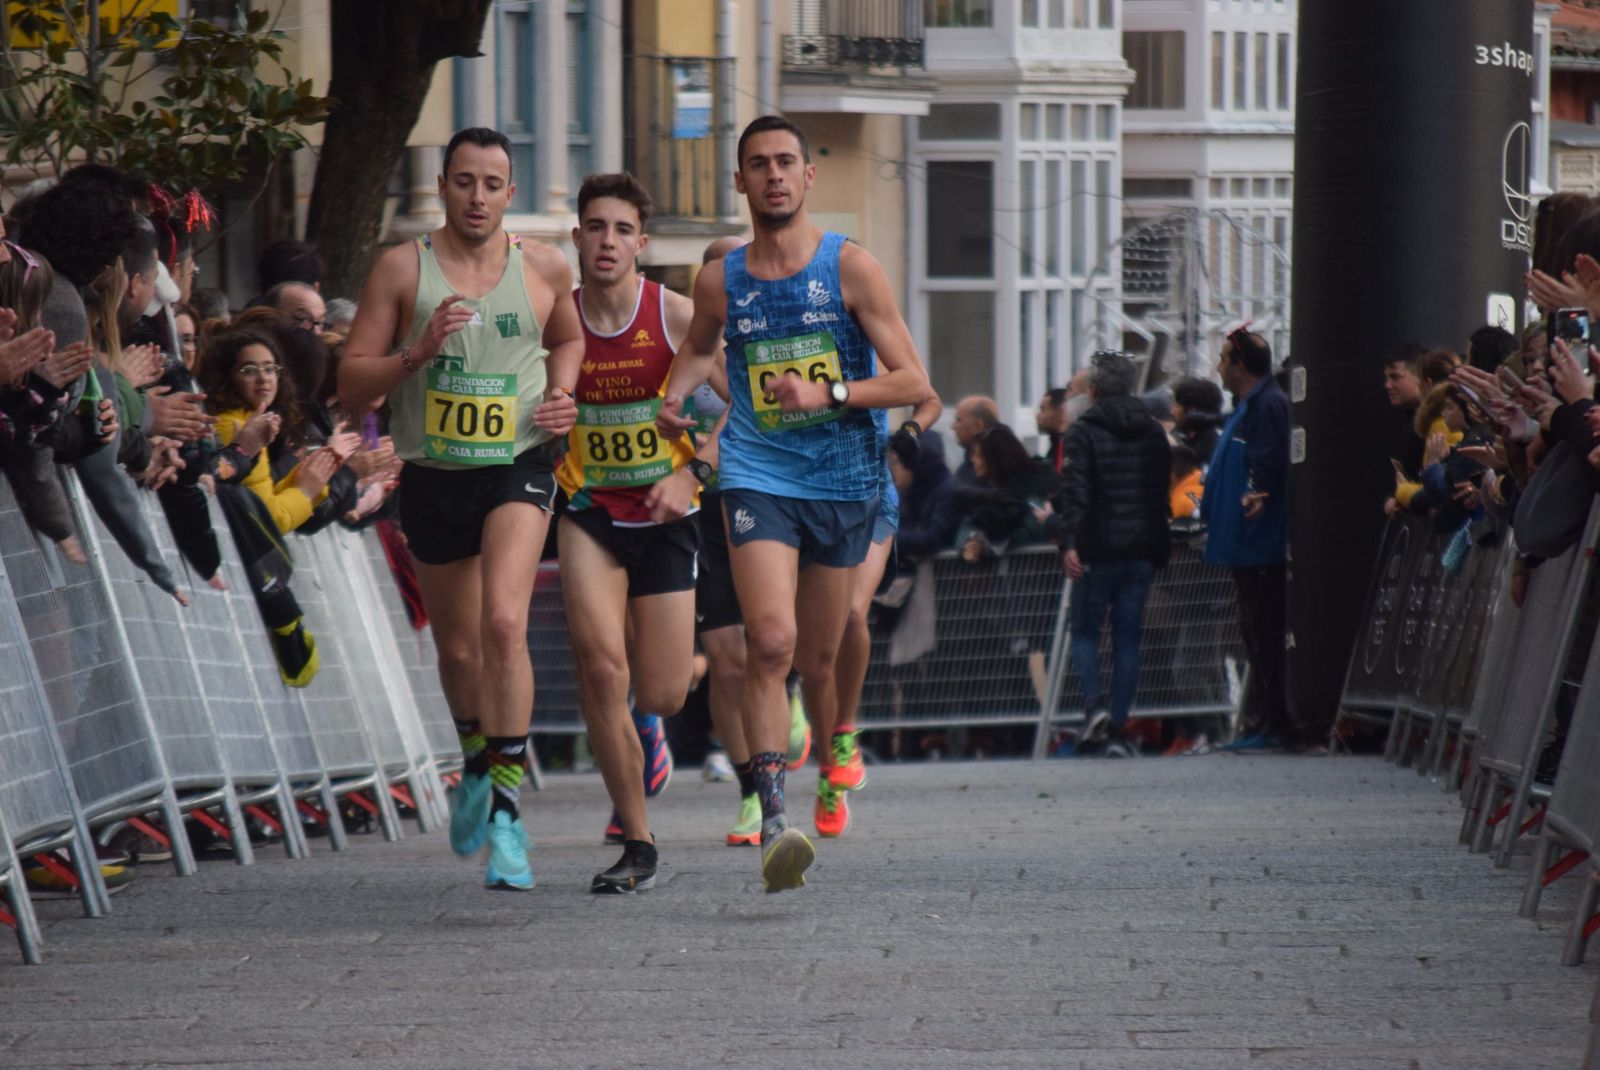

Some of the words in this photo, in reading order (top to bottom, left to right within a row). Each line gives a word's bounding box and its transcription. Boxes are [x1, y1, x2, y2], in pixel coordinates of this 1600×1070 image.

[772, 351, 791, 361] CAJA
[598, 362, 617, 370] CAJA
[618, 359, 645, 369] RURAL
[595, 376, 632, 388] VINO
[609, 386, 646, 400] TORO
[435, 398, 504, 437] 706
[587, 428, 659, 463] 889
[448, 446, 472, 457] CAJA
[474, 447, 509, 458] RURAL
[609, 471, 632, 481] CAJA
